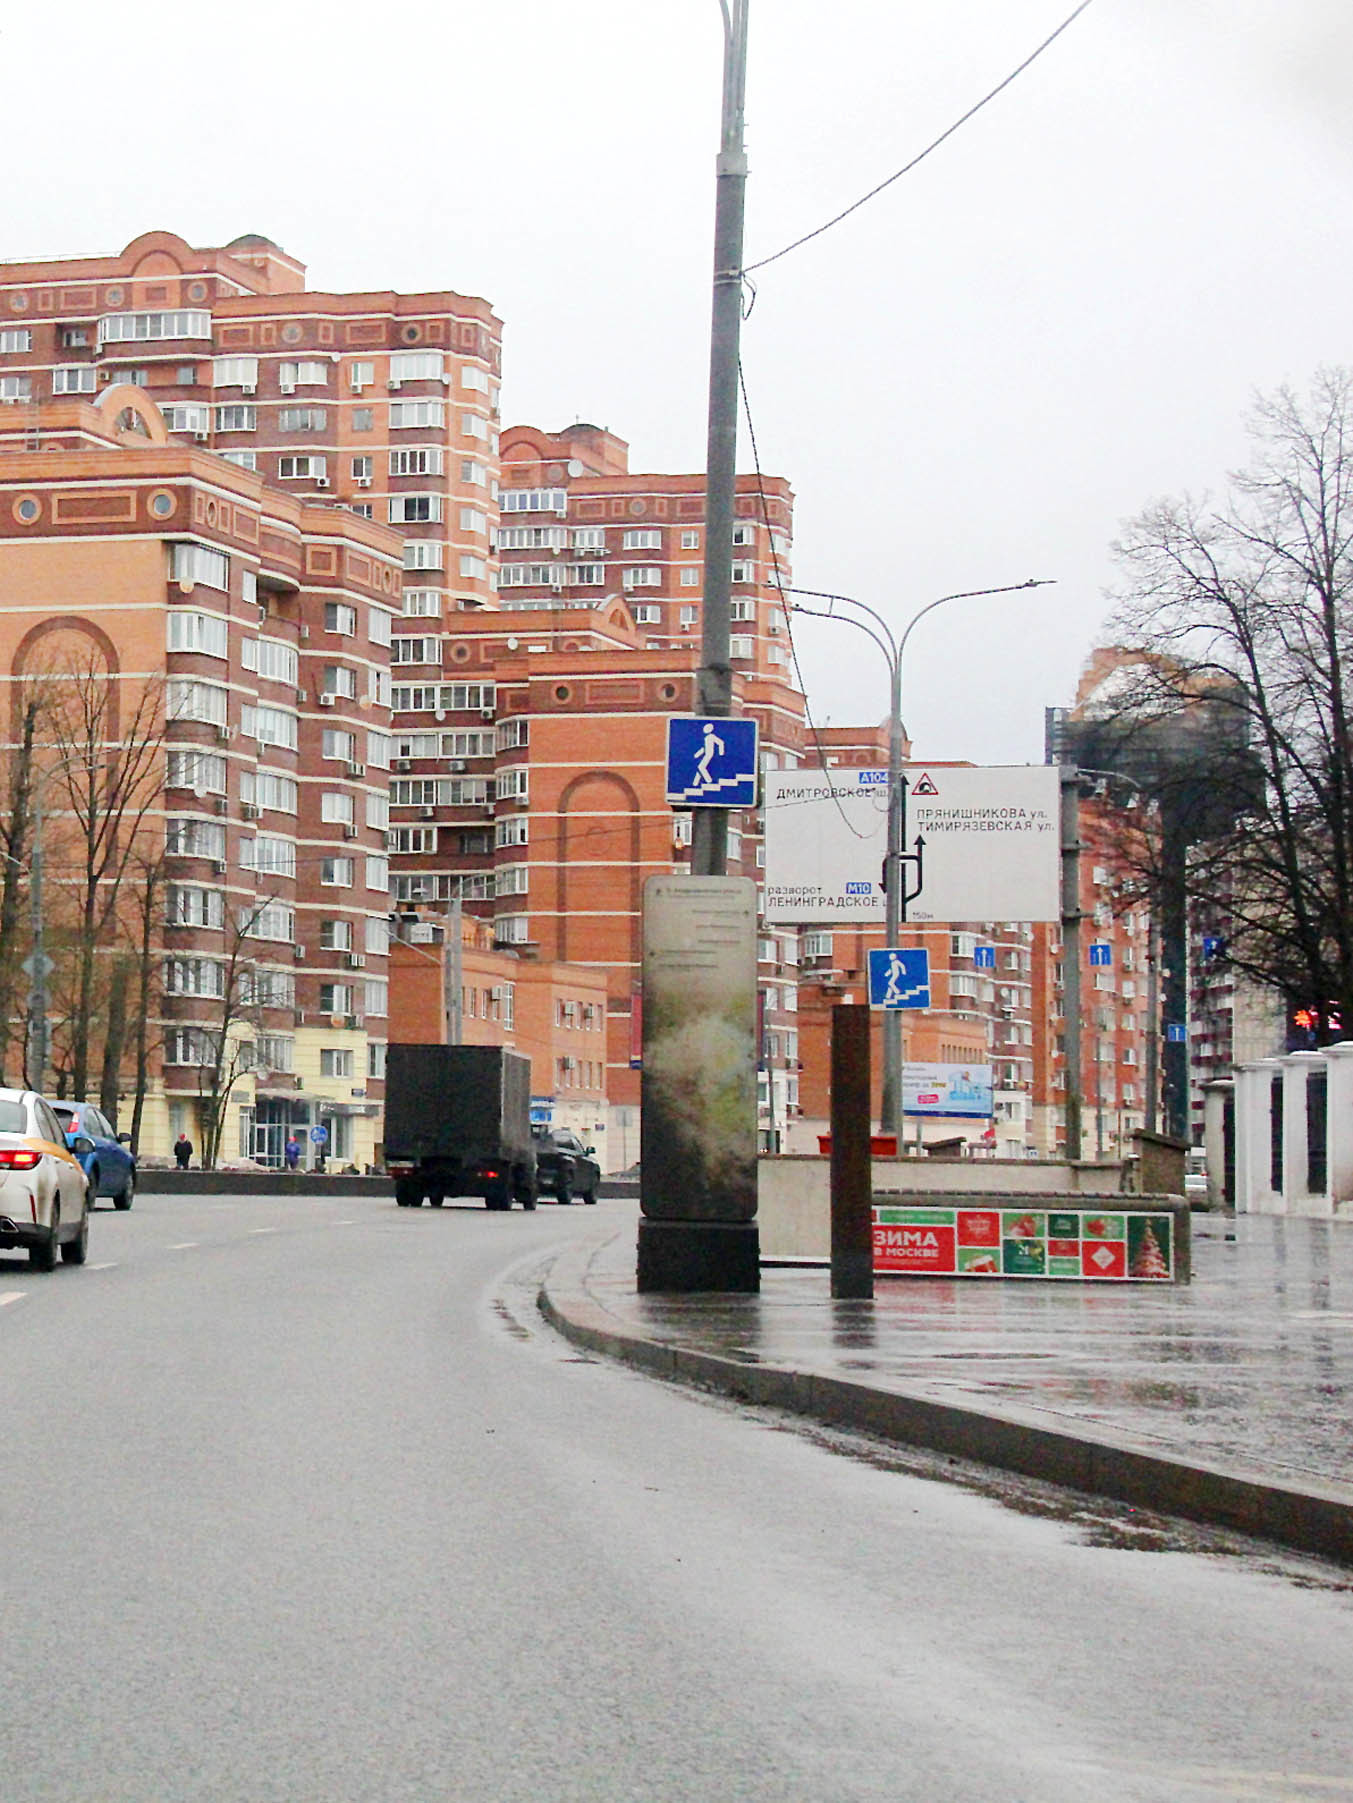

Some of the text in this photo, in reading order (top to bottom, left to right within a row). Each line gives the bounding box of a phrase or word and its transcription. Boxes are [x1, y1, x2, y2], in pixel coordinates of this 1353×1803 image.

[776, 787, 872, 800] ДМИТРОВСКОЕ
[916, 808, 1048, 820] ПРЯНИШНИКОВА ул.
[918, 820, 1055, 833] ТИМИРЯЗЕВСКАЯ ул.
[767, 885, 823, 897] разворот
[767, 896, 879, 908] ЛЕНИНГРАДСКОЕ
[872, 1230, 939, 1247] ЗИМА
[885, 1247, 940, 1258] МОСКВЕ
